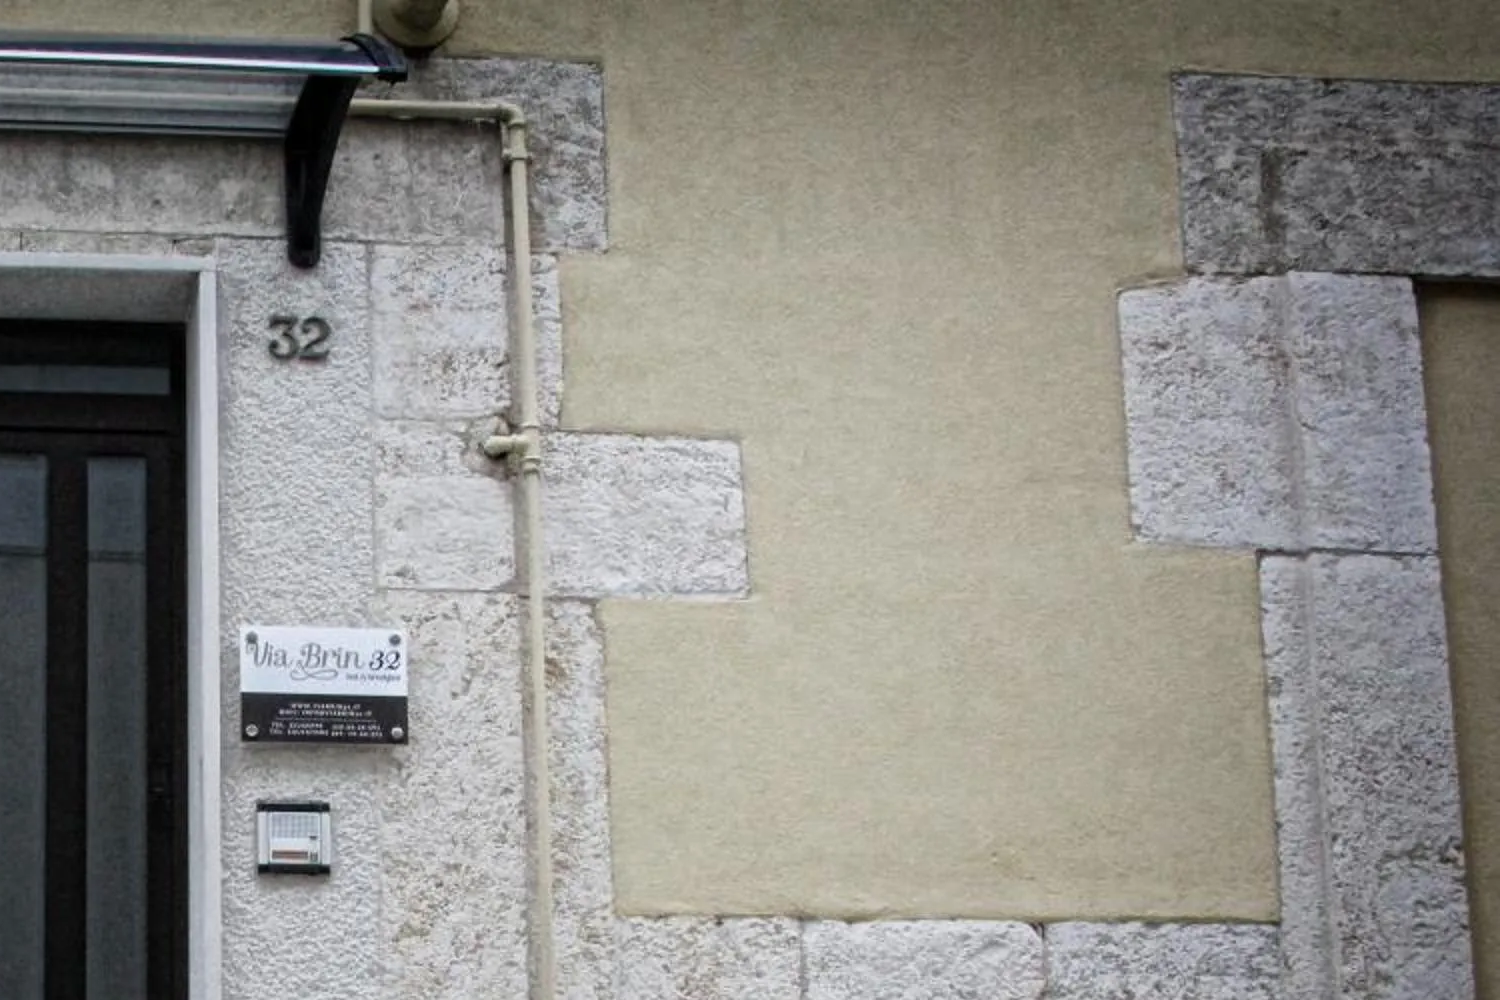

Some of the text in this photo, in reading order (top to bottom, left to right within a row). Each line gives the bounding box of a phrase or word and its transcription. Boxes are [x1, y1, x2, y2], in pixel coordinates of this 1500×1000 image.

[268, 315, 331, 362] 32
[246, 641, 401, 671] Via Brin 32
